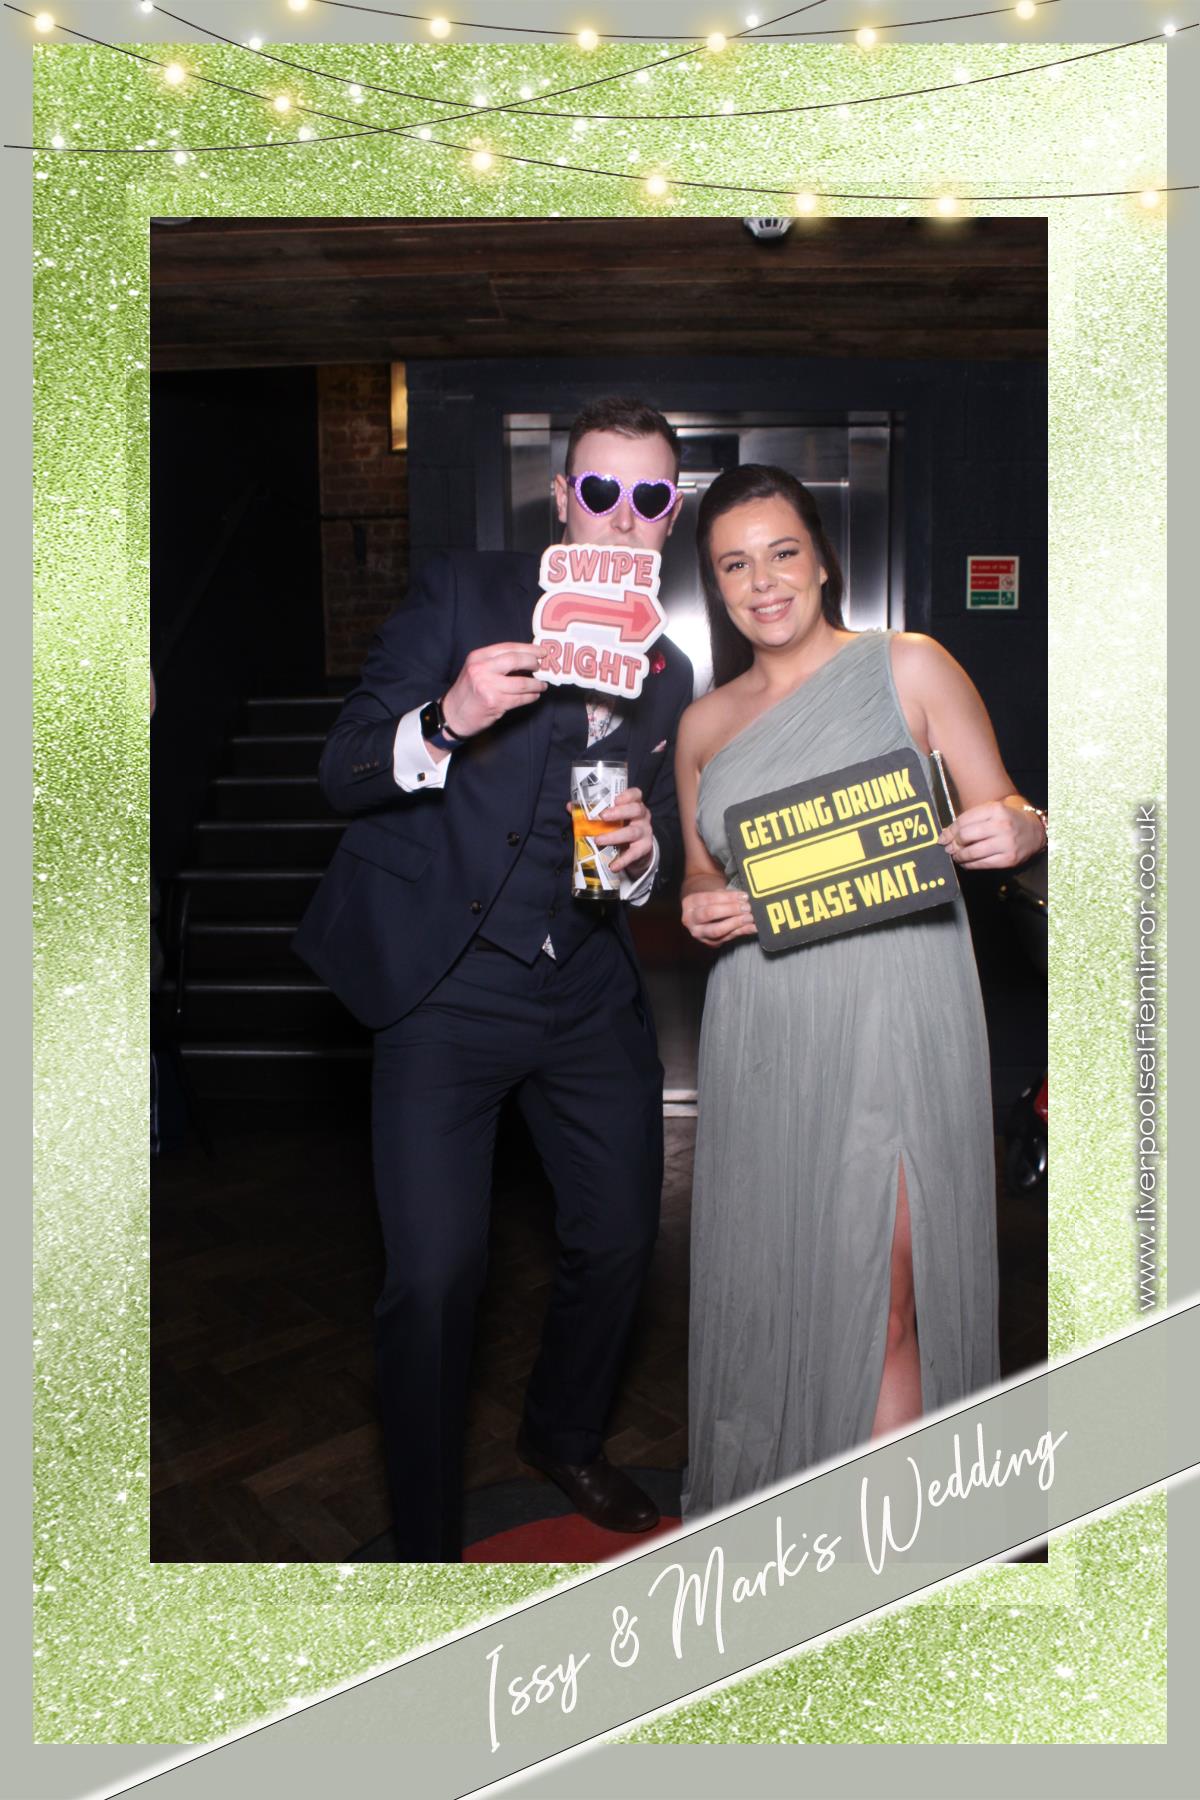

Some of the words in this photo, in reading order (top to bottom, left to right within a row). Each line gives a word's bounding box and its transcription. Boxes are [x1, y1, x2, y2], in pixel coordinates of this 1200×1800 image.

[547, 549, 654, 588] SWIPE
[539, 638, 642, 690] RIGHT
[739, 796, 834, 850] GETTING
[831, 767, 917, 821] DRUNK
[878, 814, 929, 848] 69%
[765, 877, 858, 935] PLEASE
[854, 860, 946, 908] WAIT...
